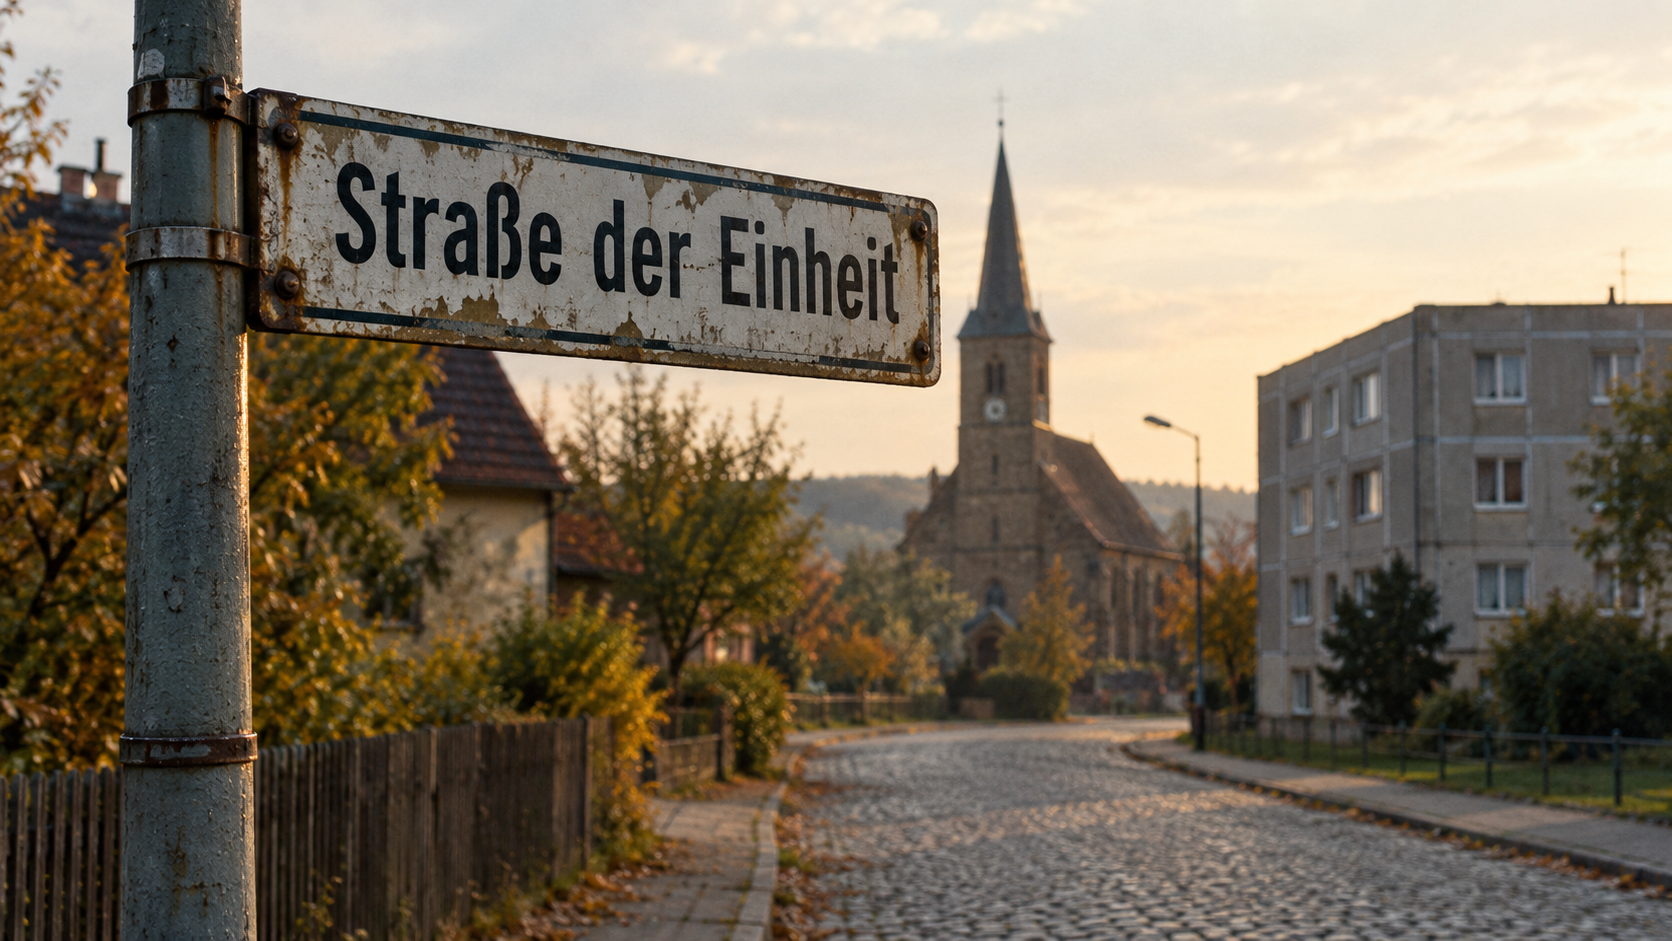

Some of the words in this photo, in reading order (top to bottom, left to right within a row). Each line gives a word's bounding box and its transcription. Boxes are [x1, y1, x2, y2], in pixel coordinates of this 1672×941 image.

[335, 161, 563, 286] Straße
[593, 198, 692, 299] der
[720, 215, 901, 325] Einheit
